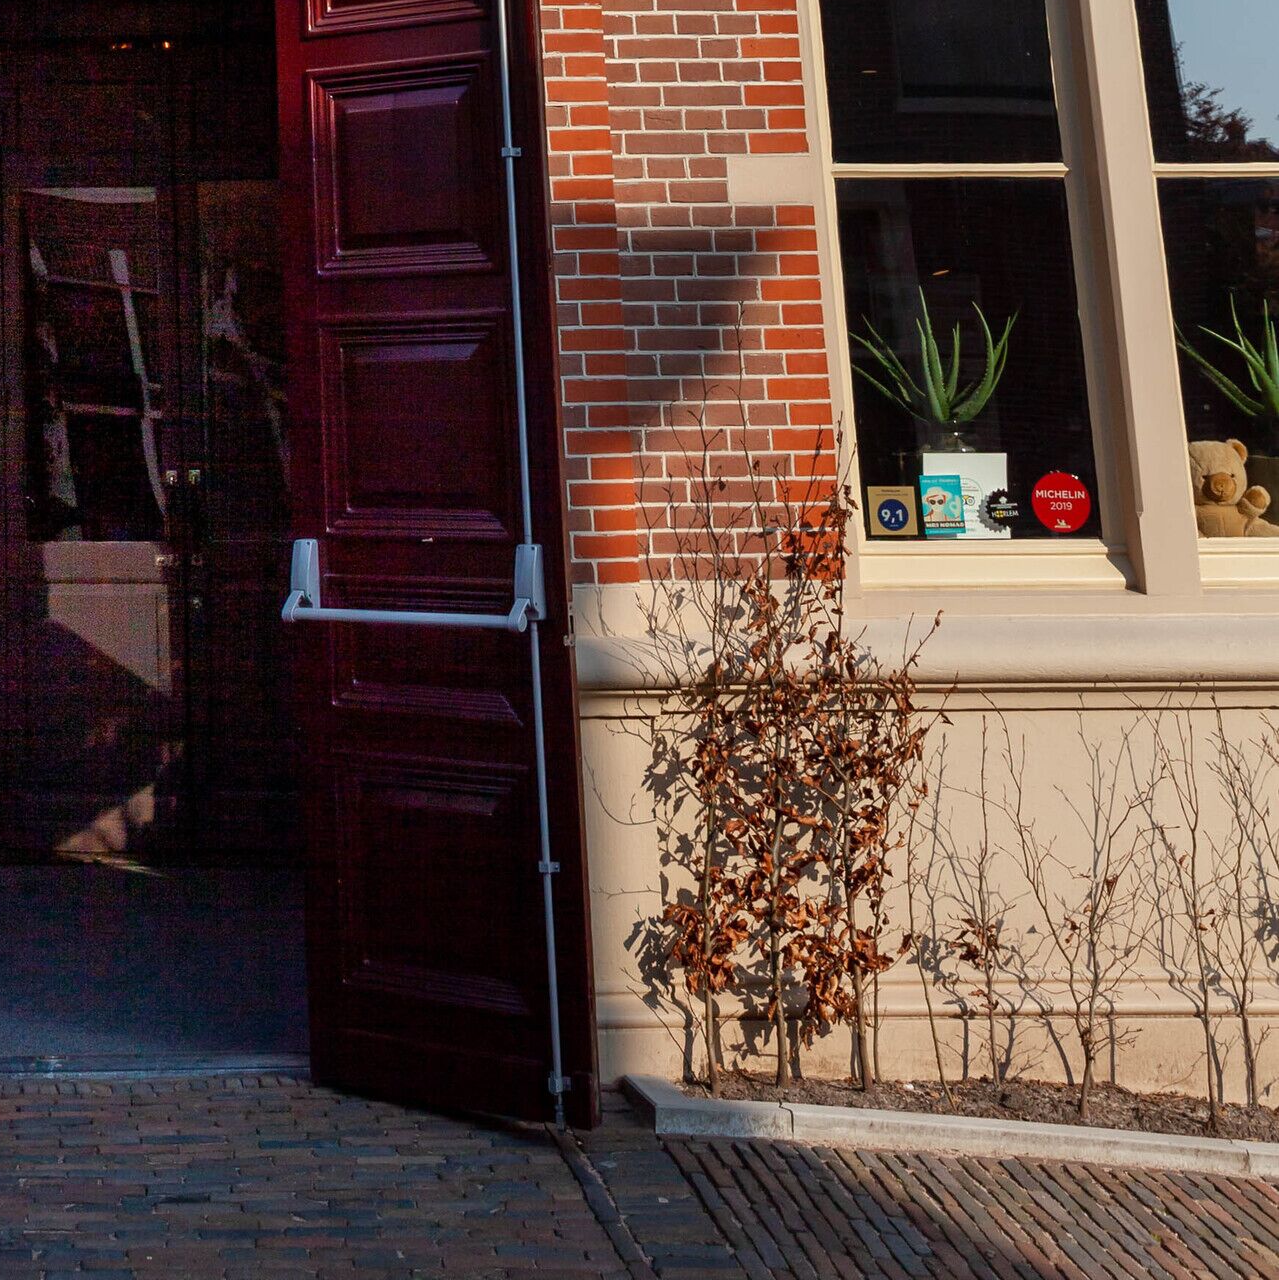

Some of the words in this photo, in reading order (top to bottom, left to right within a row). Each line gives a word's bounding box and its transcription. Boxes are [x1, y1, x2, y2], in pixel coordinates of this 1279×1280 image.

[1035, 489, 1086, 499] MICHELIN
[1050, 501, 1073, 511] 2019
[881, 509, 904, 524] 9,1
